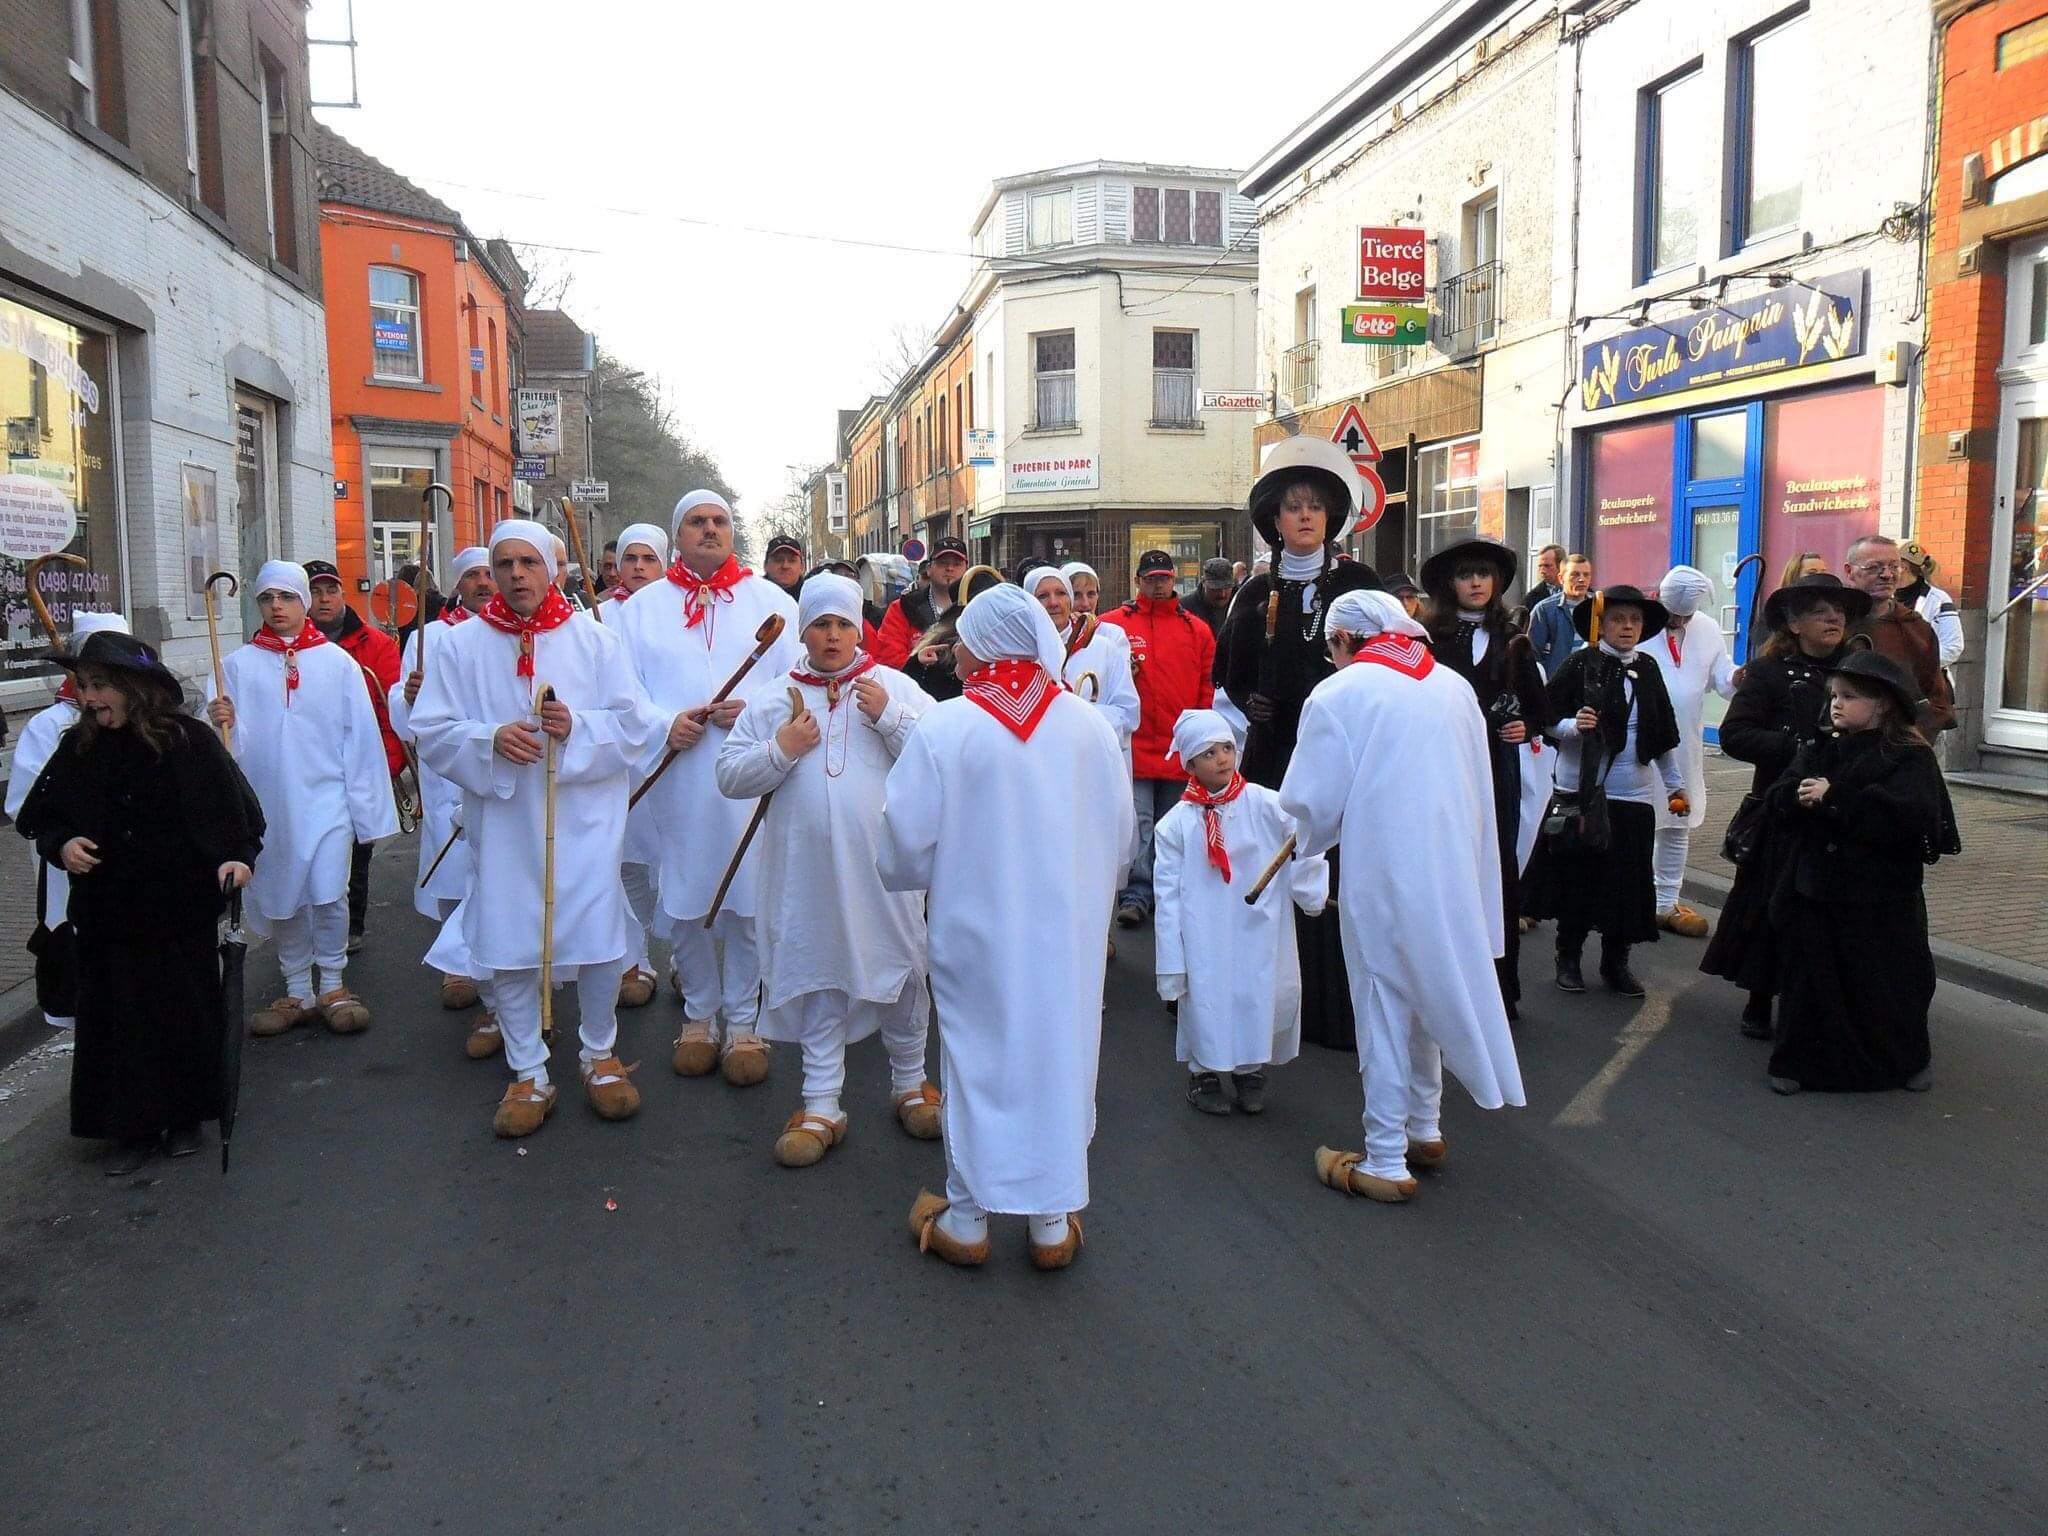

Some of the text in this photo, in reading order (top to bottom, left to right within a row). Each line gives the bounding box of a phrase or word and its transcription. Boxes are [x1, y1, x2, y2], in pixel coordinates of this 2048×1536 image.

[1362, 238, 1423, 259] Tiercé
[1363, 266, 1422, 290] Belge
[1355, 315, 1416, 334] Lotto 6
[520, 392, 557, 401] FRITERIE
[1012, 459, 1092, 473] EPICERIE DU PARC
[575, 486, 606, 495] Jupiler
[1786, 474, 1867, 494] Boulangerie
[1600, 494, 1656, 510] Boulangerie
[1782, 495, 1869, 513] Sandwicherie
[1598, 510, 1657, 526] Sandwicherie
